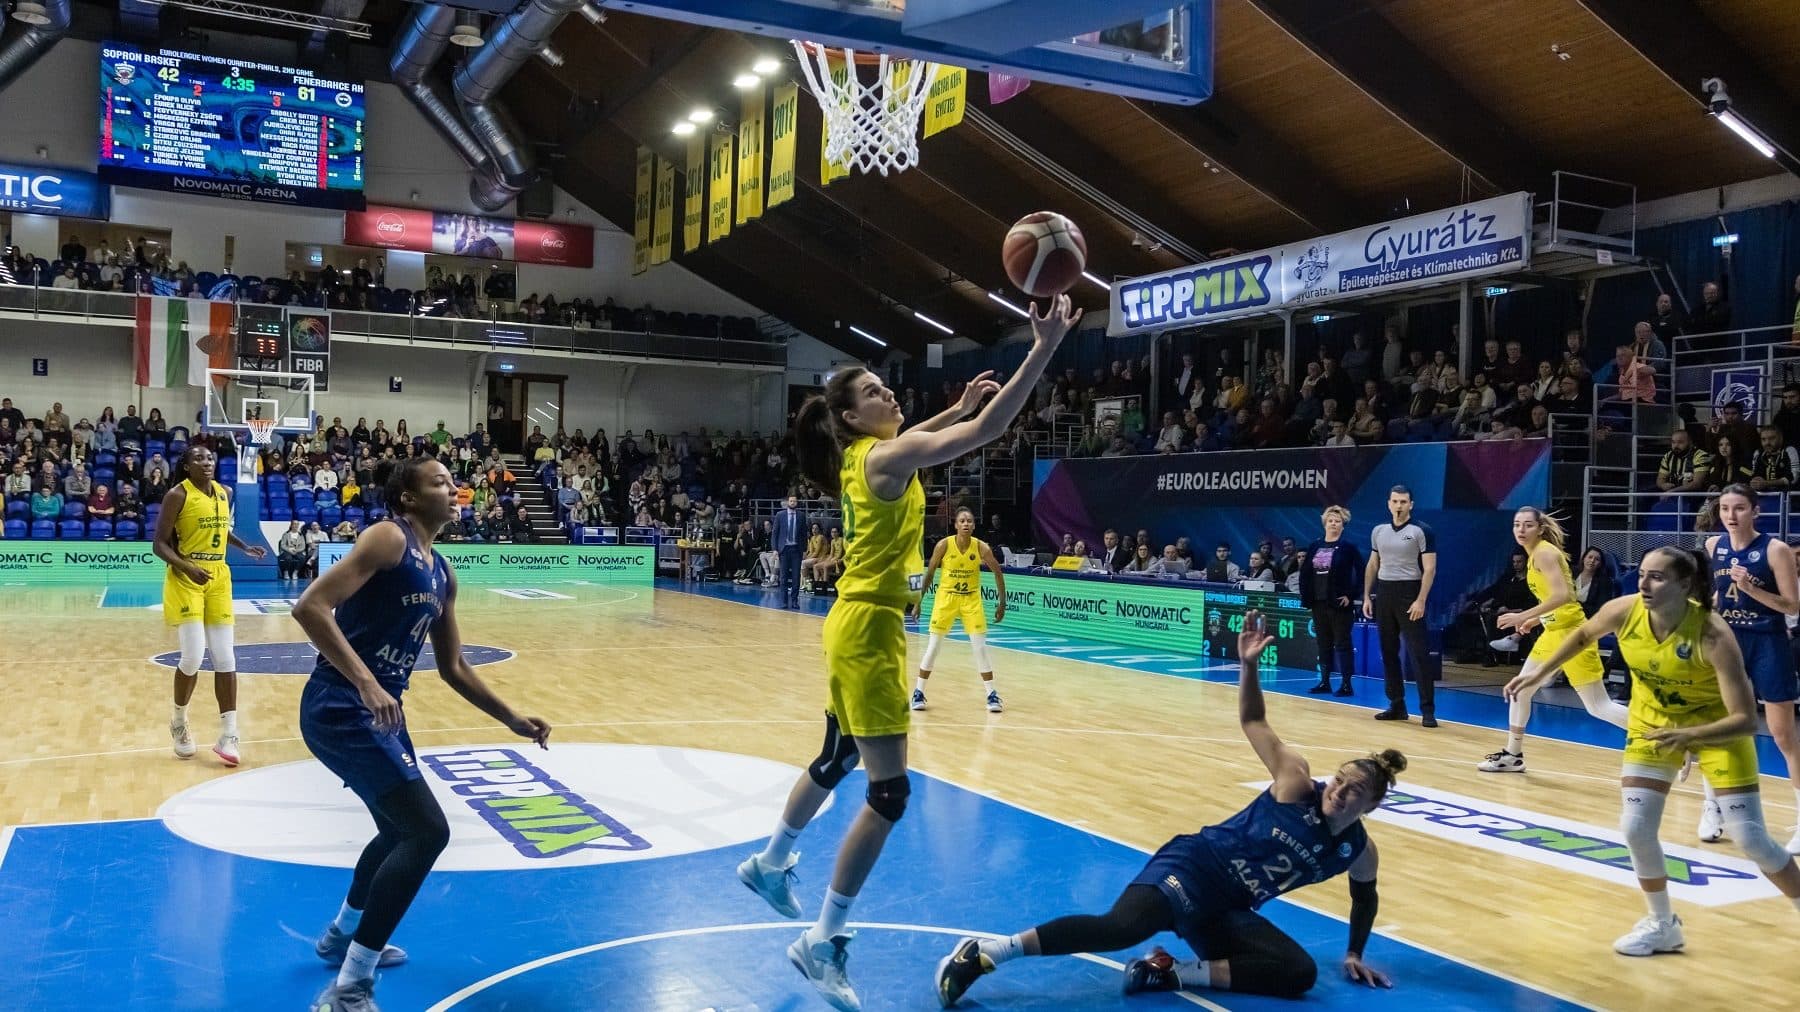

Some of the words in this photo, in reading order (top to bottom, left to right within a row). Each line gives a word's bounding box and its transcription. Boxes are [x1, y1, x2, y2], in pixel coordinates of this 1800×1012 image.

[103, 49, 142, 62] SOPRON
[144, 54, 181, 68] BASKET
[160, 49, 201, 61] EUROLEAGUE
[201, 55, 226, 65] WOMEN
[296, 69, 314, 77] GAME
[158, 67, 179, 82] 42
[231, 67, 240, 77] 3
[194, 85, 202, 96] 2
[222, 76, 255, 92] 4:35
[294, 76, 350, 92] FENERBAHCE
[272, 96, 281, 107] 3
[298, 87, 316, 102] 61
[0, 174, 62, 202] TIC
[174, 176, 251, 195] NOVOMATIC
[1364, 209, 1497, 272] Gyurátz
[1340, 269, 1409, 291] Épületgépészet
[1411, 266, 1422, 277] és
[1424, 252, 1498, 276] Klímatechnika
[1500, 248, 1520, 262] Kft.
[37, 360, 44, 372] E
[296, 358, 324, 372] FIBA
[1157, 469, 1328, 490] #EUROLEAGUEWOMEN
[212, 534, 221, 548] 5
[64, 552, 153, 564] NOVOMATIC
[500, 554, 569, 565] NOVOMATIC
[578, 555, 644, 565] NOVOMATIC
[954, 582, 968, 591] 42
[1725, 582, 1739, 602] 4
[981, 586, 1035, 606] NOVMATIC
[1043, 593, 1108, 616] NOVOMATIC
[1116, 600, 1191, 625] NOVOMATIC
[1279, 619, 1294, 638] 61
[1203, 640, 1210, 656] 2
[1262, 854, 1302, 891] 21
